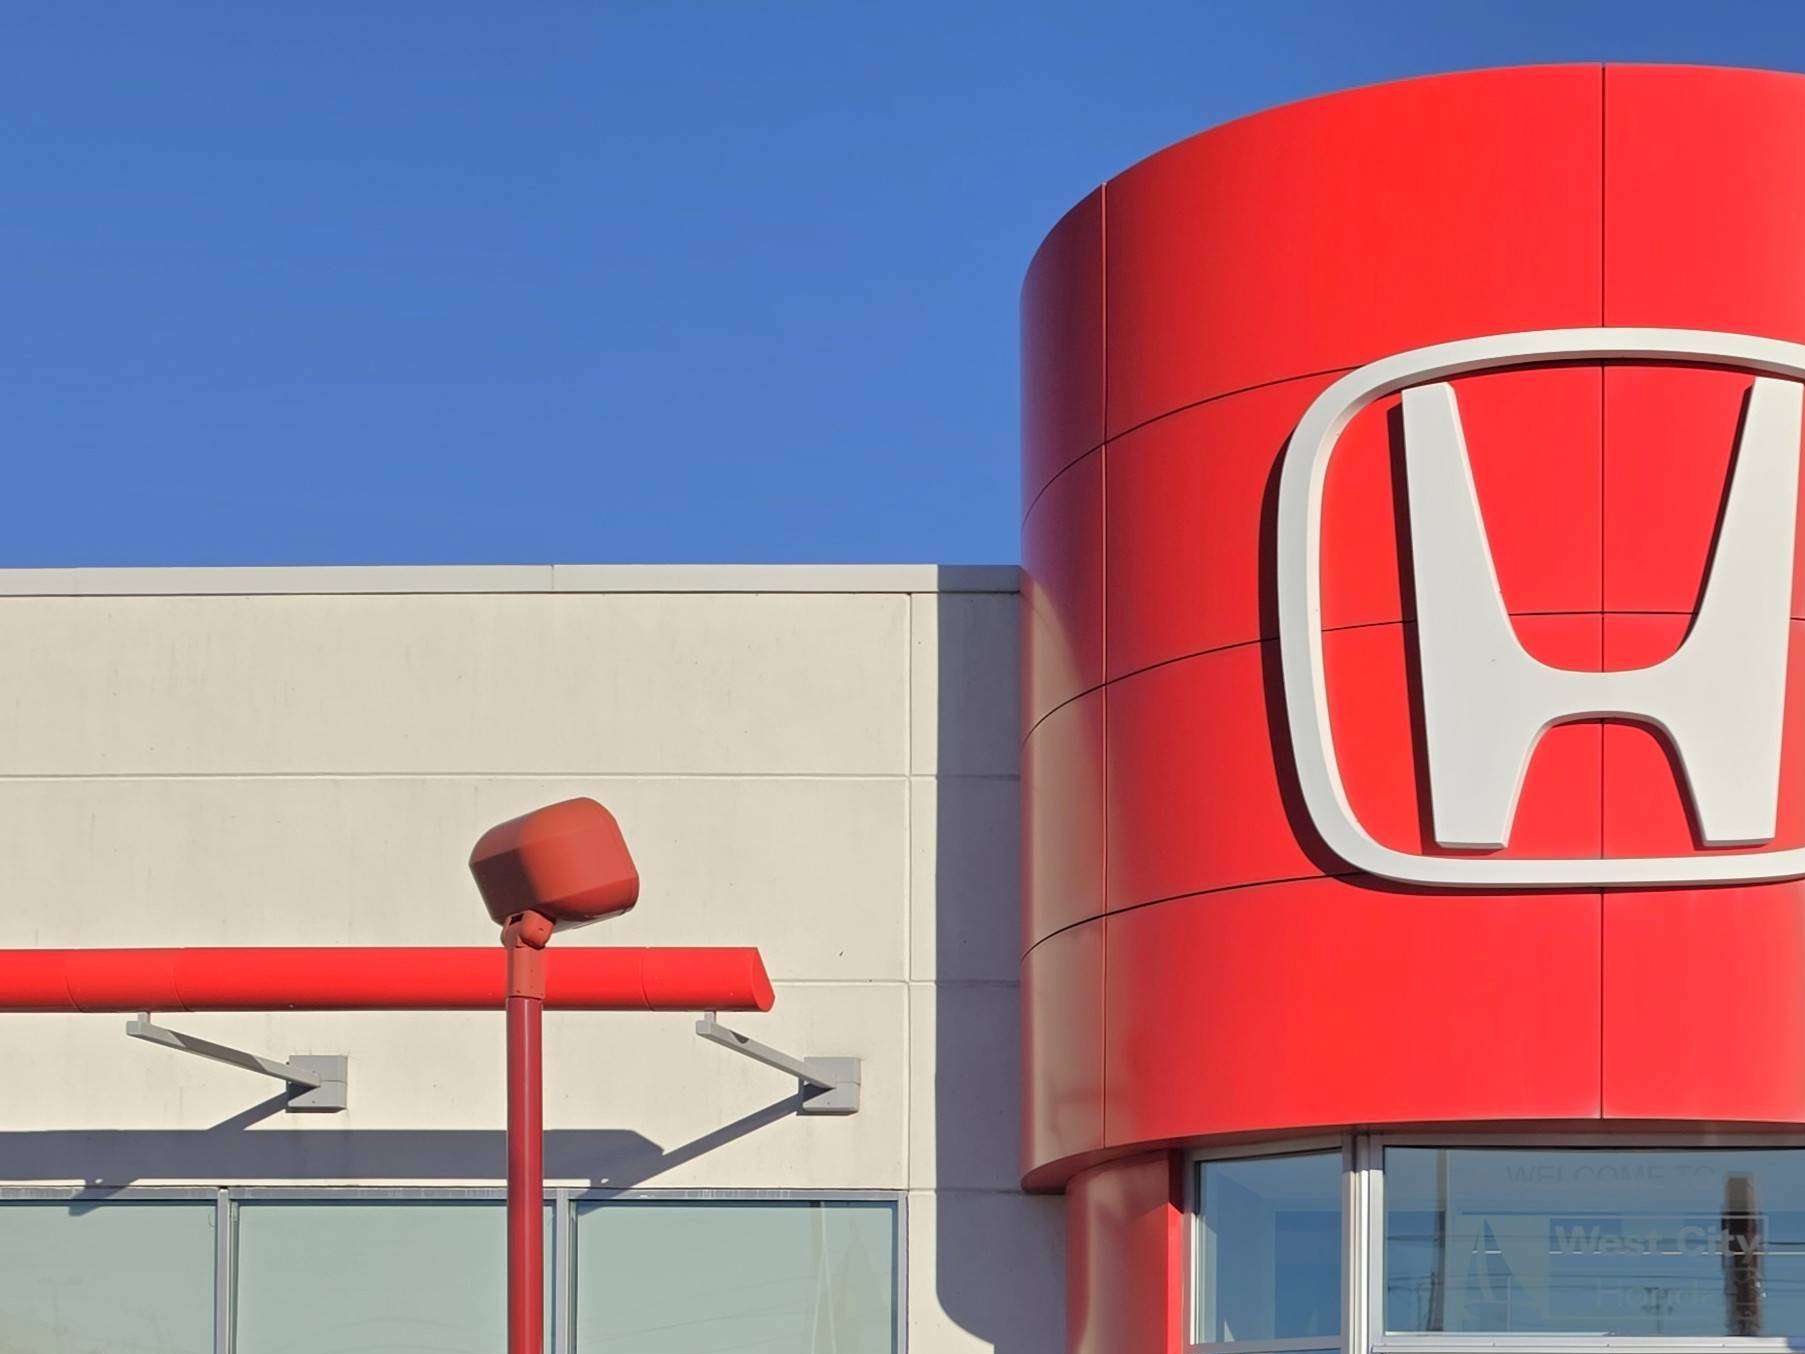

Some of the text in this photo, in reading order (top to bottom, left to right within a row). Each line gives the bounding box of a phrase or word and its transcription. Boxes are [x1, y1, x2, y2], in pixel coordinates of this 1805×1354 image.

[1505, 1164, 1665, 1184] WELCOME
[1554, 1224, 1761, 1265] West City
